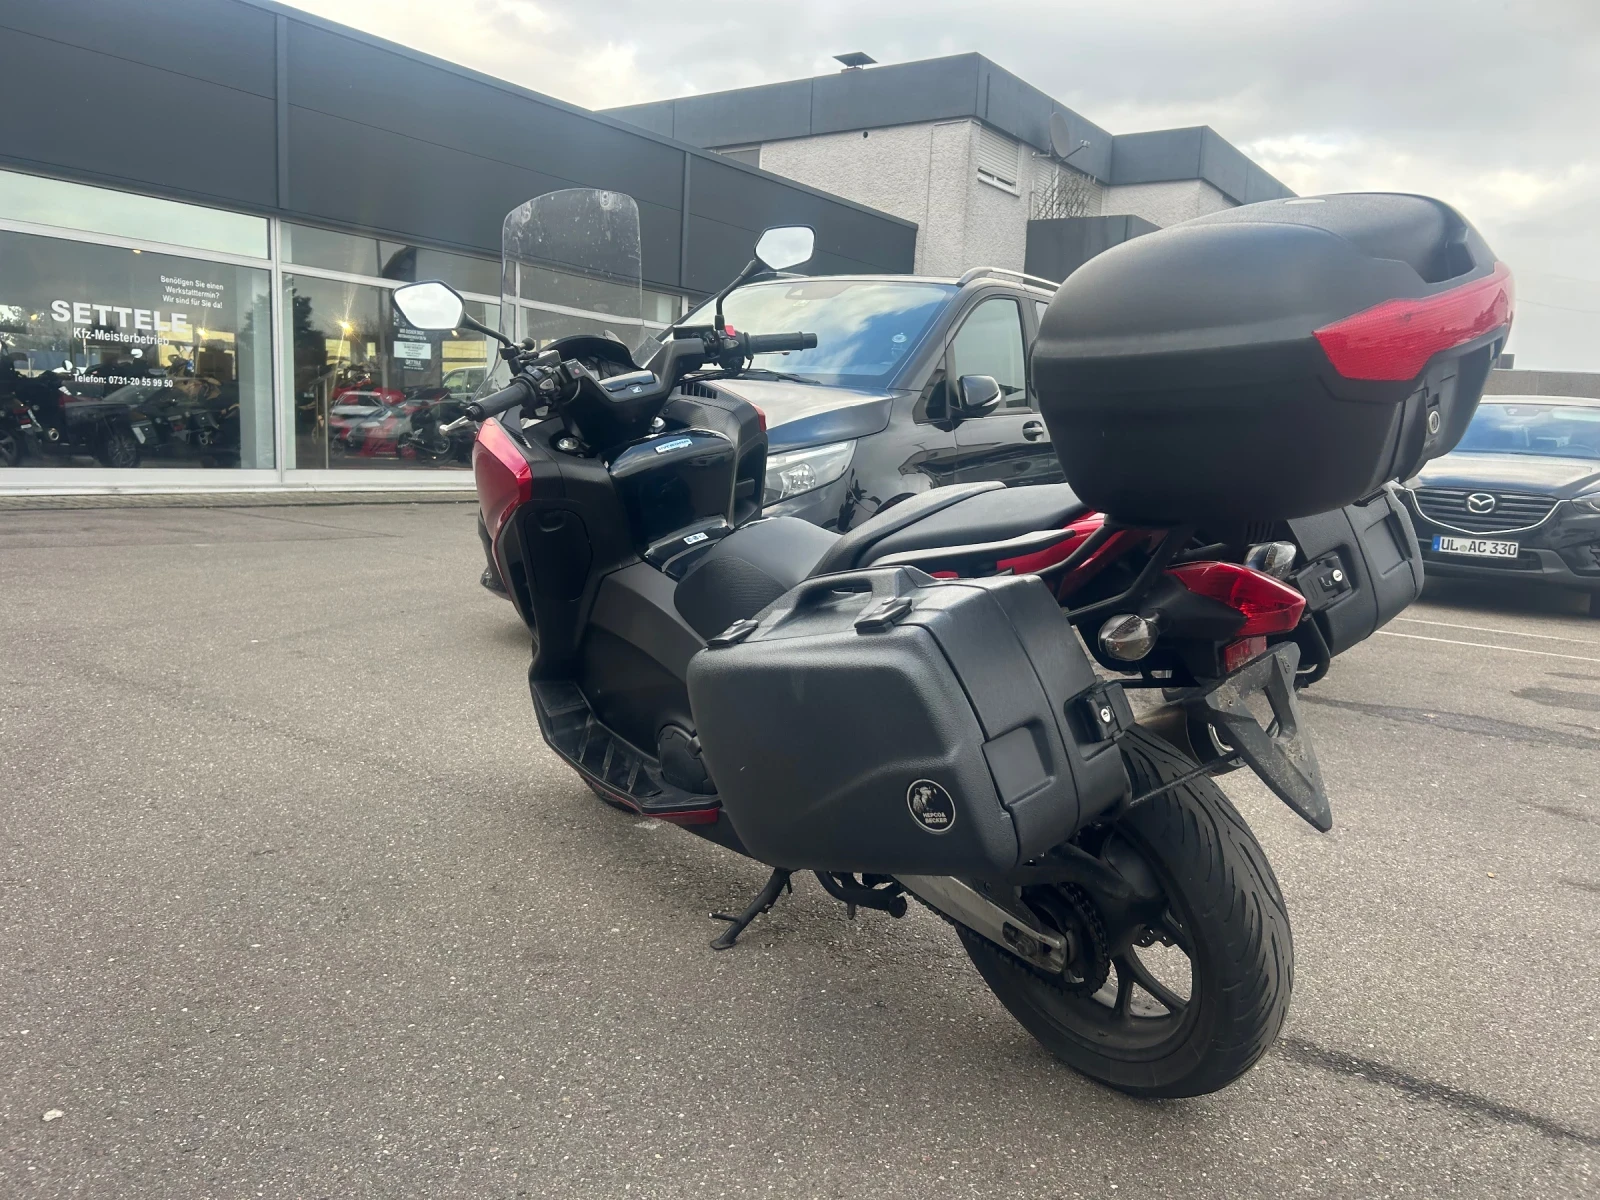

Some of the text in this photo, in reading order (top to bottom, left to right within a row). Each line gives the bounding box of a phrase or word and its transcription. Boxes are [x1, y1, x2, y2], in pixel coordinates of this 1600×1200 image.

[160, 275, 224, 290] Benötigen Sie einen
[162, 294, 174, 302] Wir
[190, 298, 200, 306] für
[201, 300, 211, 308] Sie
[51, 300, 188, 333] SETTELE
[73, 327, 169, 346] Kfz-Meisterbetrieb
[73, 373, 173, 388] Telefon: 0731-20 55 99 50
[1441, 539, 1517, 556] UL AC 330
